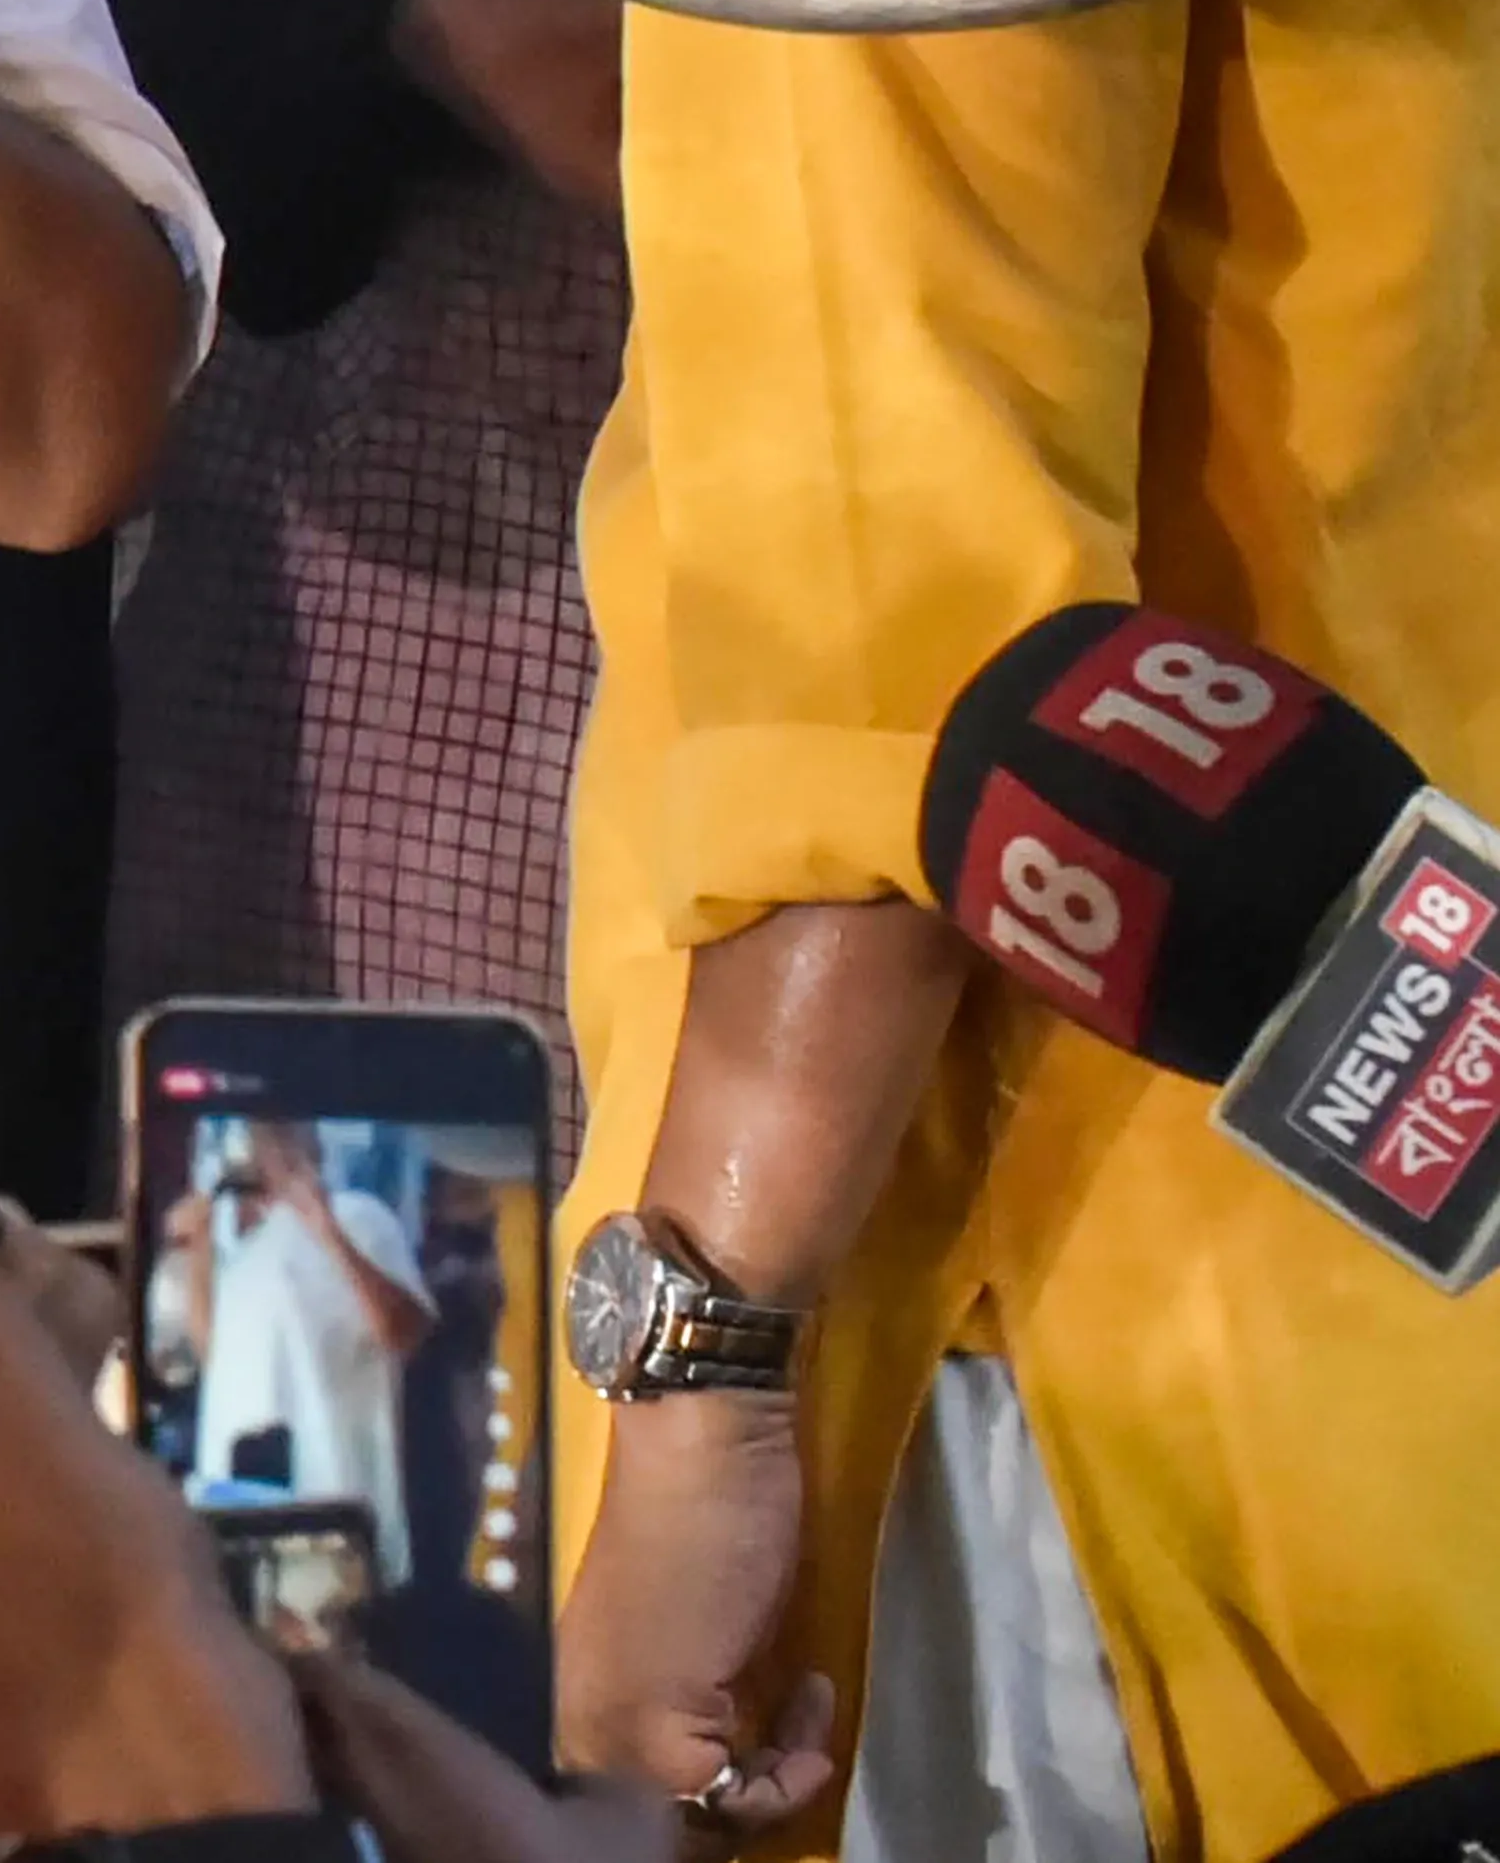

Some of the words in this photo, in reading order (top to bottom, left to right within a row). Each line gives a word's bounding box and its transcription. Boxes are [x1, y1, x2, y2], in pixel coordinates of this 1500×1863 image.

[1078, 642, 1276, 770] 18
[991, 835, 1122, 999] 18
[1400, 884, 1472, 954] 18
[1306, 963, 1452, 1147] NEWS
